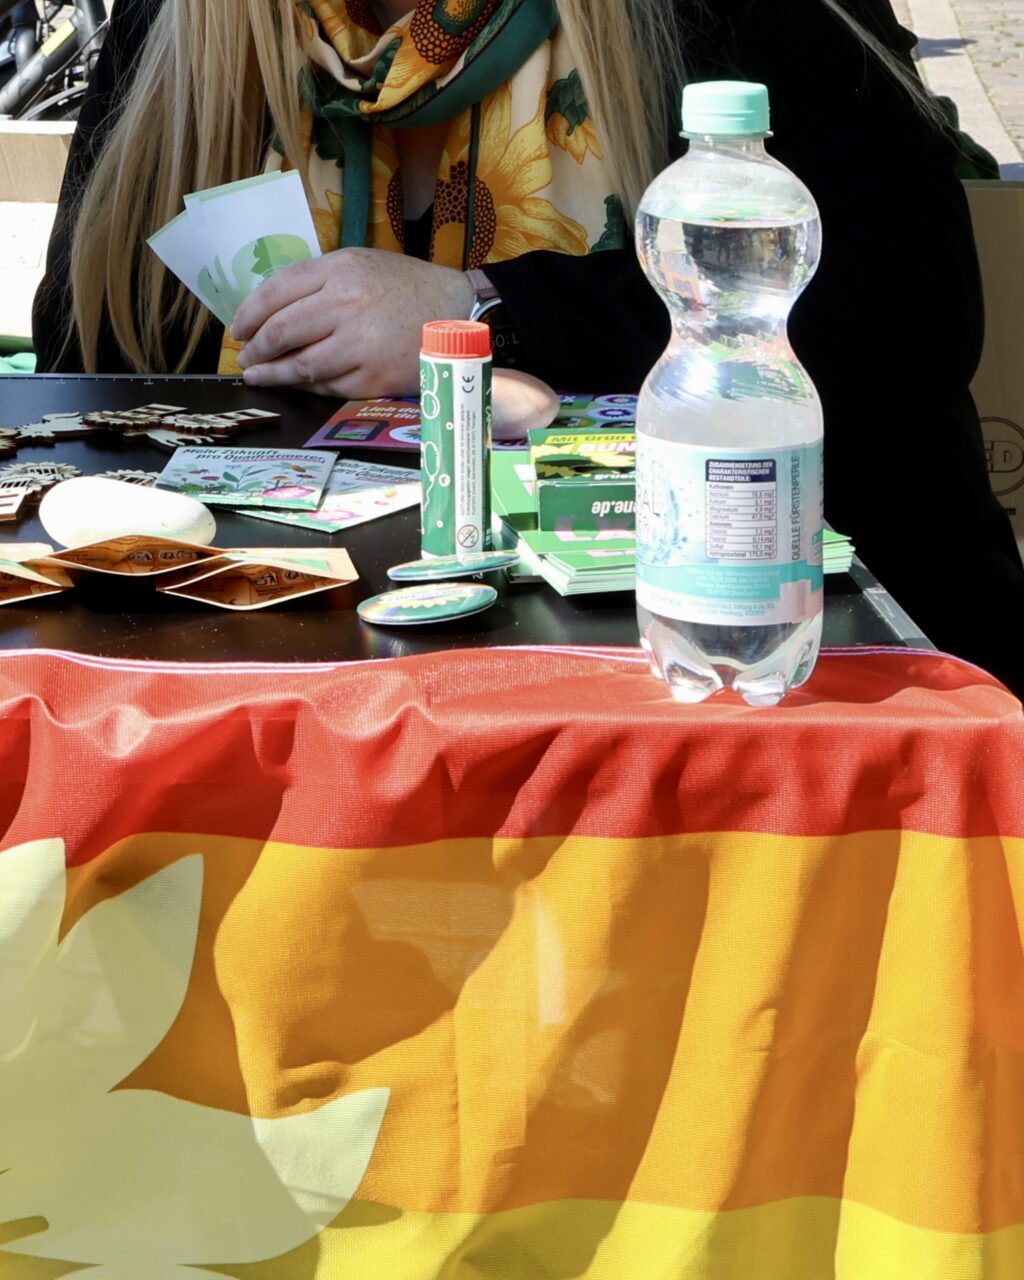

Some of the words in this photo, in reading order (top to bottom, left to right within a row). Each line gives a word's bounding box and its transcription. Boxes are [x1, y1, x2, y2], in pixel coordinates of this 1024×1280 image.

[221, 448, 279, 456] Zukunft
[577, 442, 636, 453] BUN
[791, 455, 800, 526] FÜRSTENPERLE
[792, 529, 800, 560] QUELLE
